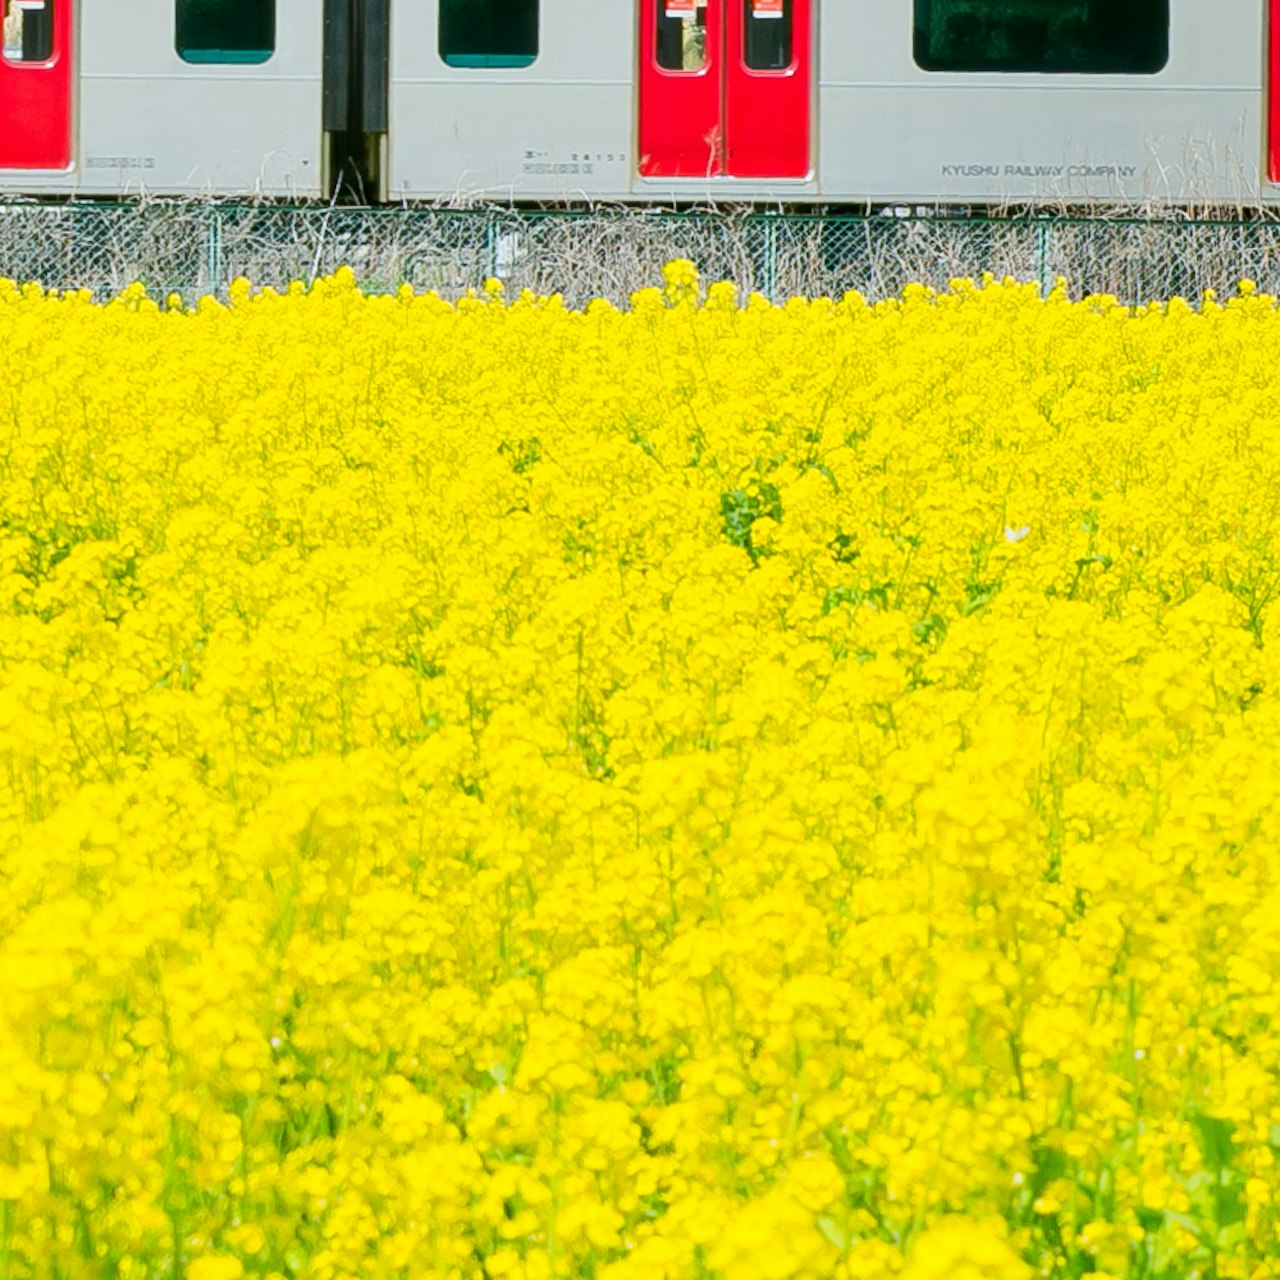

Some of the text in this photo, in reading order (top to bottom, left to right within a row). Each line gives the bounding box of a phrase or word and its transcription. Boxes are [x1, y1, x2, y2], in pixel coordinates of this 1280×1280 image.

[942, 165, 1137, 178] KYUSHU RAILWAY COMPANY
